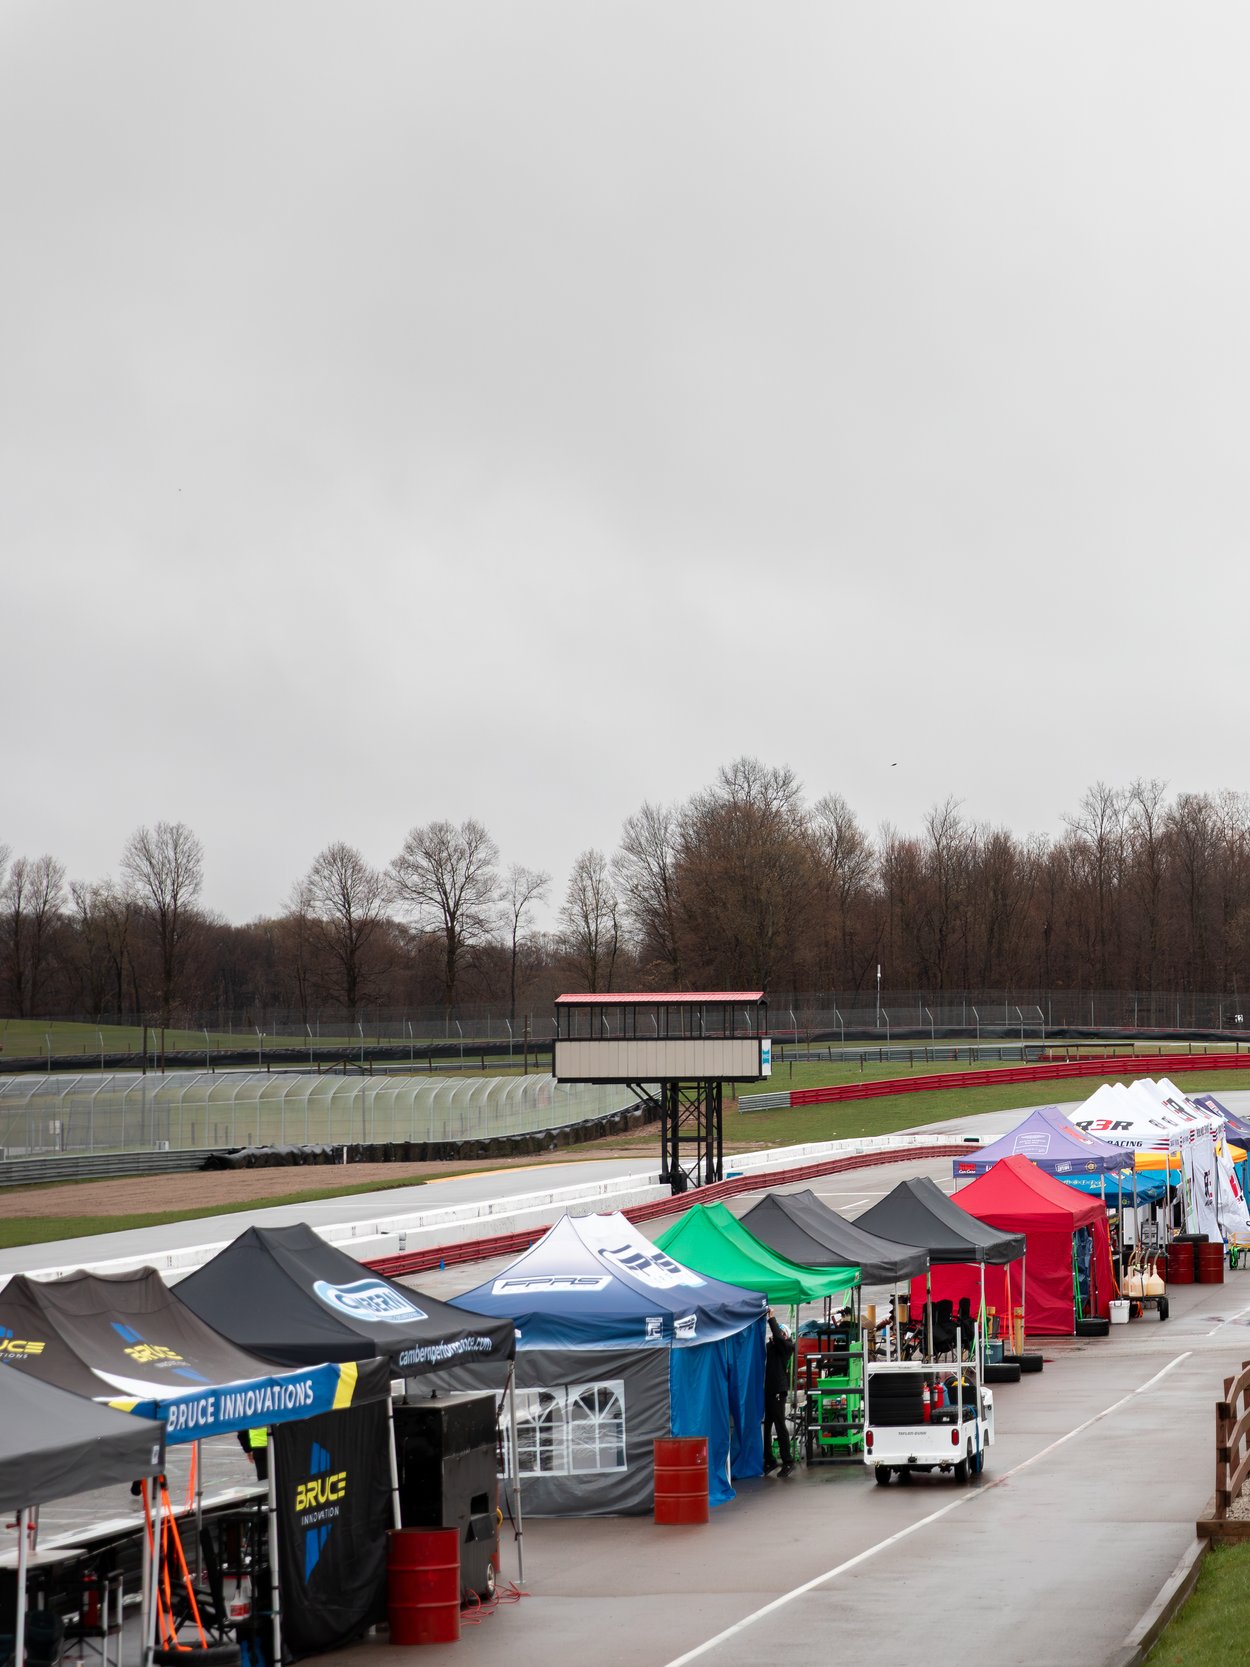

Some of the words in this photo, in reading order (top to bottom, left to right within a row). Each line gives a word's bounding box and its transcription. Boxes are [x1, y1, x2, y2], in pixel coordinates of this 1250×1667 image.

[166, 1397, 216, 1432] BRUCE
[219, 1380, 314, 1420] INNOVATIONS
[296, 1471, 347, 1512] BRUCE
